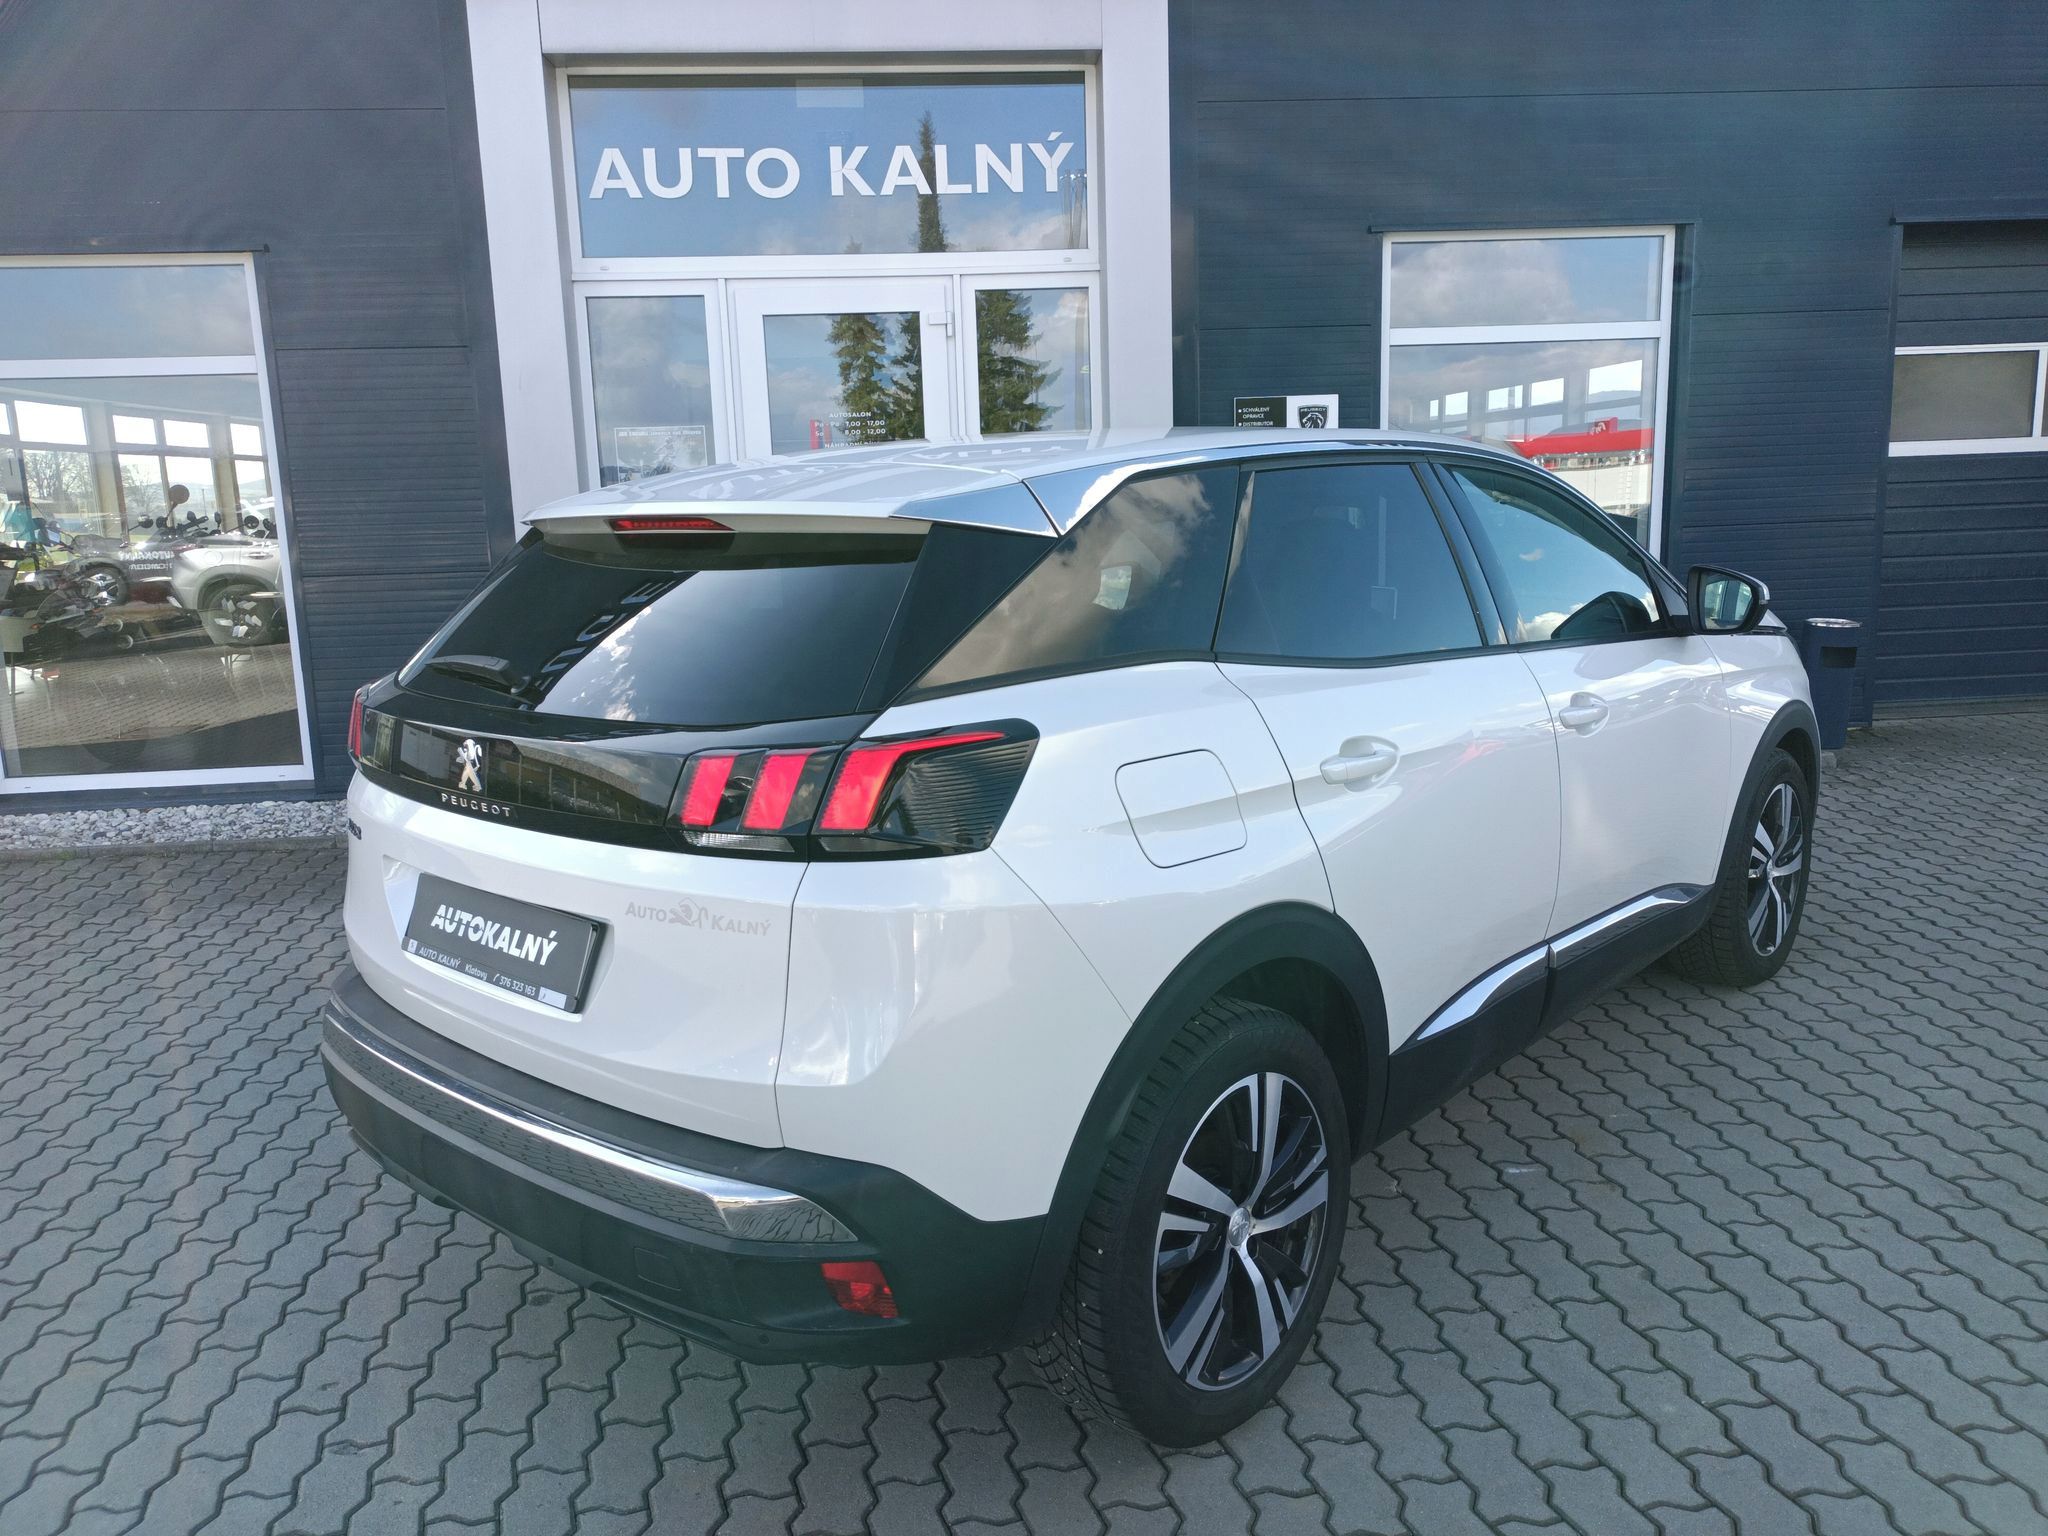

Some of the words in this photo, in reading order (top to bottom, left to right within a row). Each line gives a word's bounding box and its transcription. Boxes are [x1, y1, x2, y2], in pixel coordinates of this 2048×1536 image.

[589, 147, 801, 199] AUTO
[829, 131, 1075, 197] KALNÝ
[867, 419, 886, 427] 17,00
[441, 792, 511, 817] PEUGEOT
[430, 904, 558, 967] AUTOKALNÝ
[711, 913, 771, 937] KALNÝ
[418, 946, 438, 961] AUTO
[437, 953, 461, 969] KALNÝ
[464, 963, 488, 981] Klatovy
[499, 975, 512, 987] 376
[511, 980, 525, 991] 323
[524, 985, 537, 997] 163
